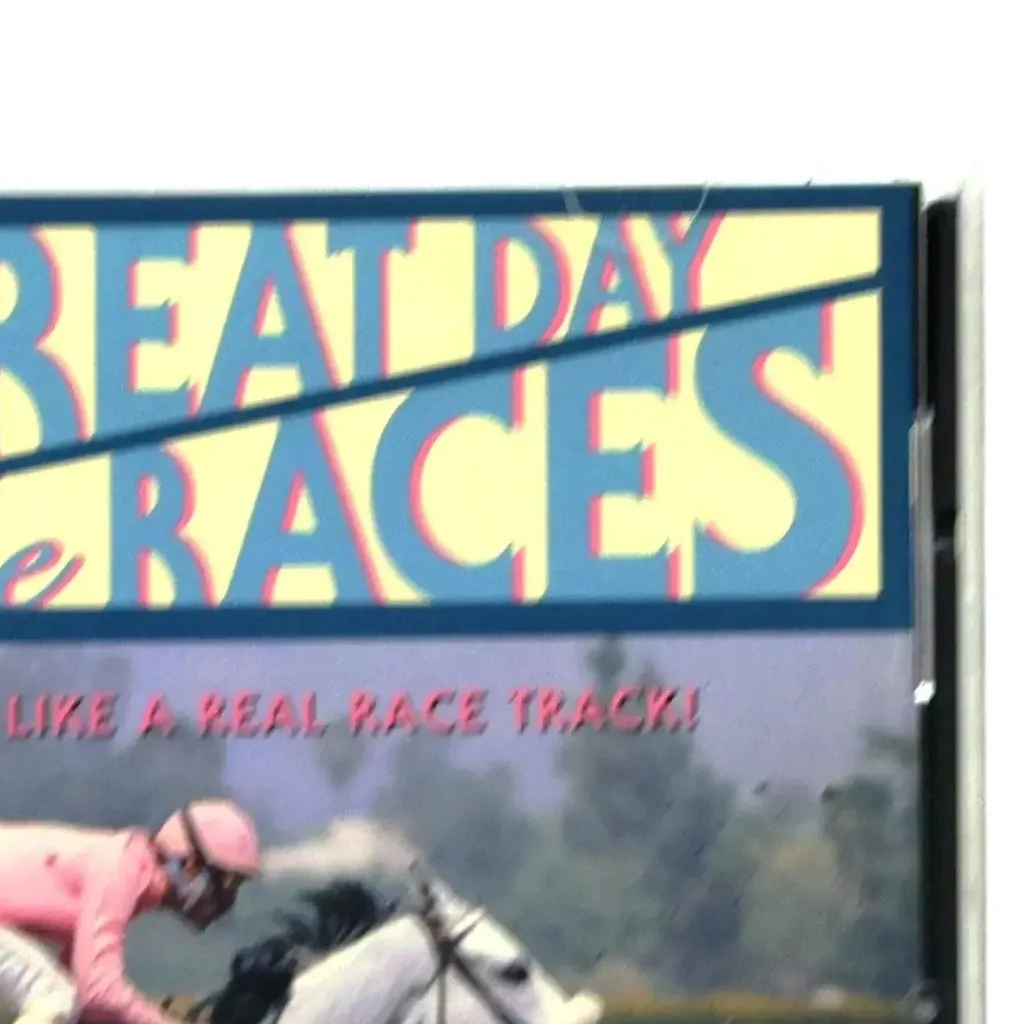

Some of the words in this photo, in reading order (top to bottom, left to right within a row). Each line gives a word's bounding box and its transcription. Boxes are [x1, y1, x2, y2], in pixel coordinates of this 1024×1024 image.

[472, 211, 726, 361] DAY
[108, 298, 865, 608] RACES
[5, 691, 120, 742] LIKE
[136, 690, 177, 738] A
[197, 690, 327, 738] REAL
[348, 687, 491, 737] RACE
[507, 684, 703, 735] TRACK!
